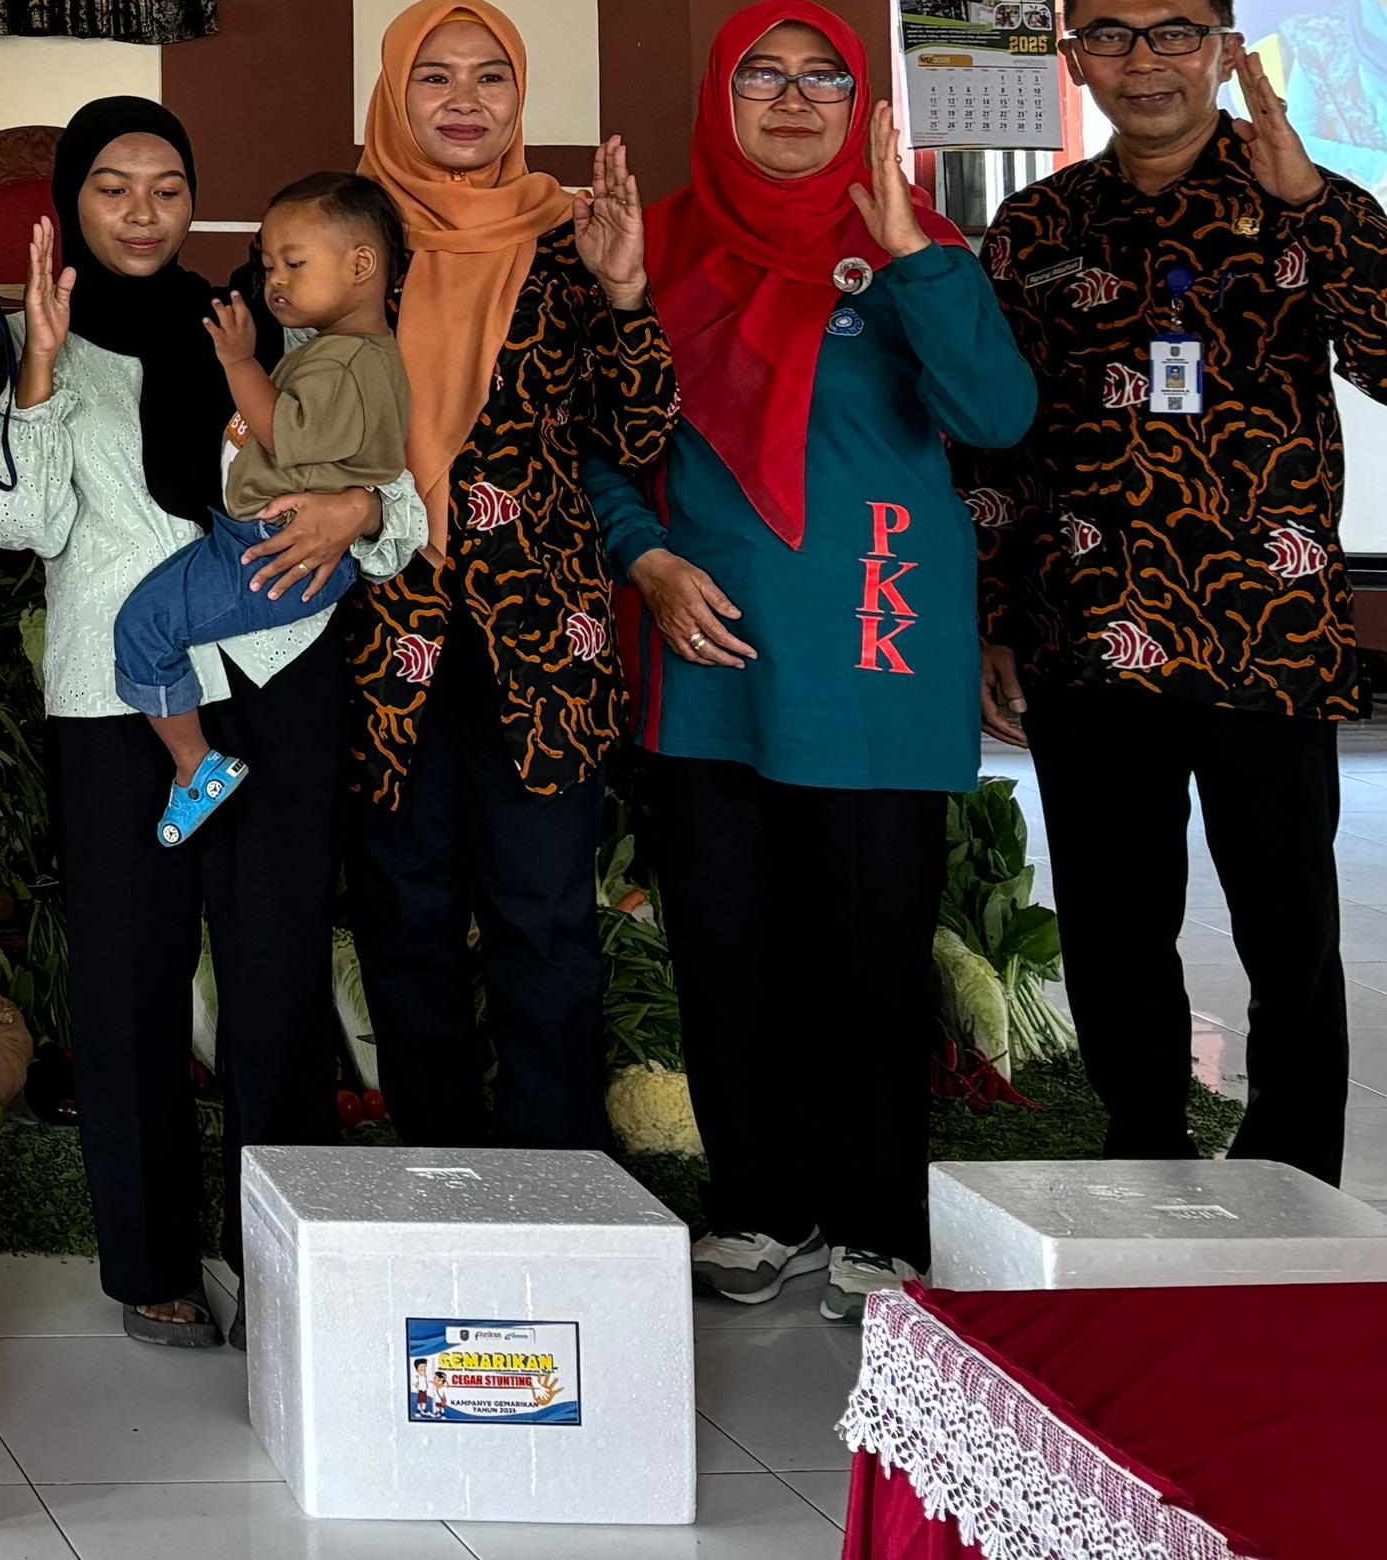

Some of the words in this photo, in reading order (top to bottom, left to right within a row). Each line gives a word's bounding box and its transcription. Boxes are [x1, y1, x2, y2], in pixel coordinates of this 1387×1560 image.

[1009, 35, 1049, 54] 2025
[854, 501, 919, 674] PKK
[438, 1351, 555, 1370] GEMARIKAN
[451, 1374, 483, 1386] CEGAH
[485, 1375, 533, 1387] STUNTING
[450, 1399, 492, 1407] KAMPANYE
[493, 1400, 539, 1408] GEMARIKAN
